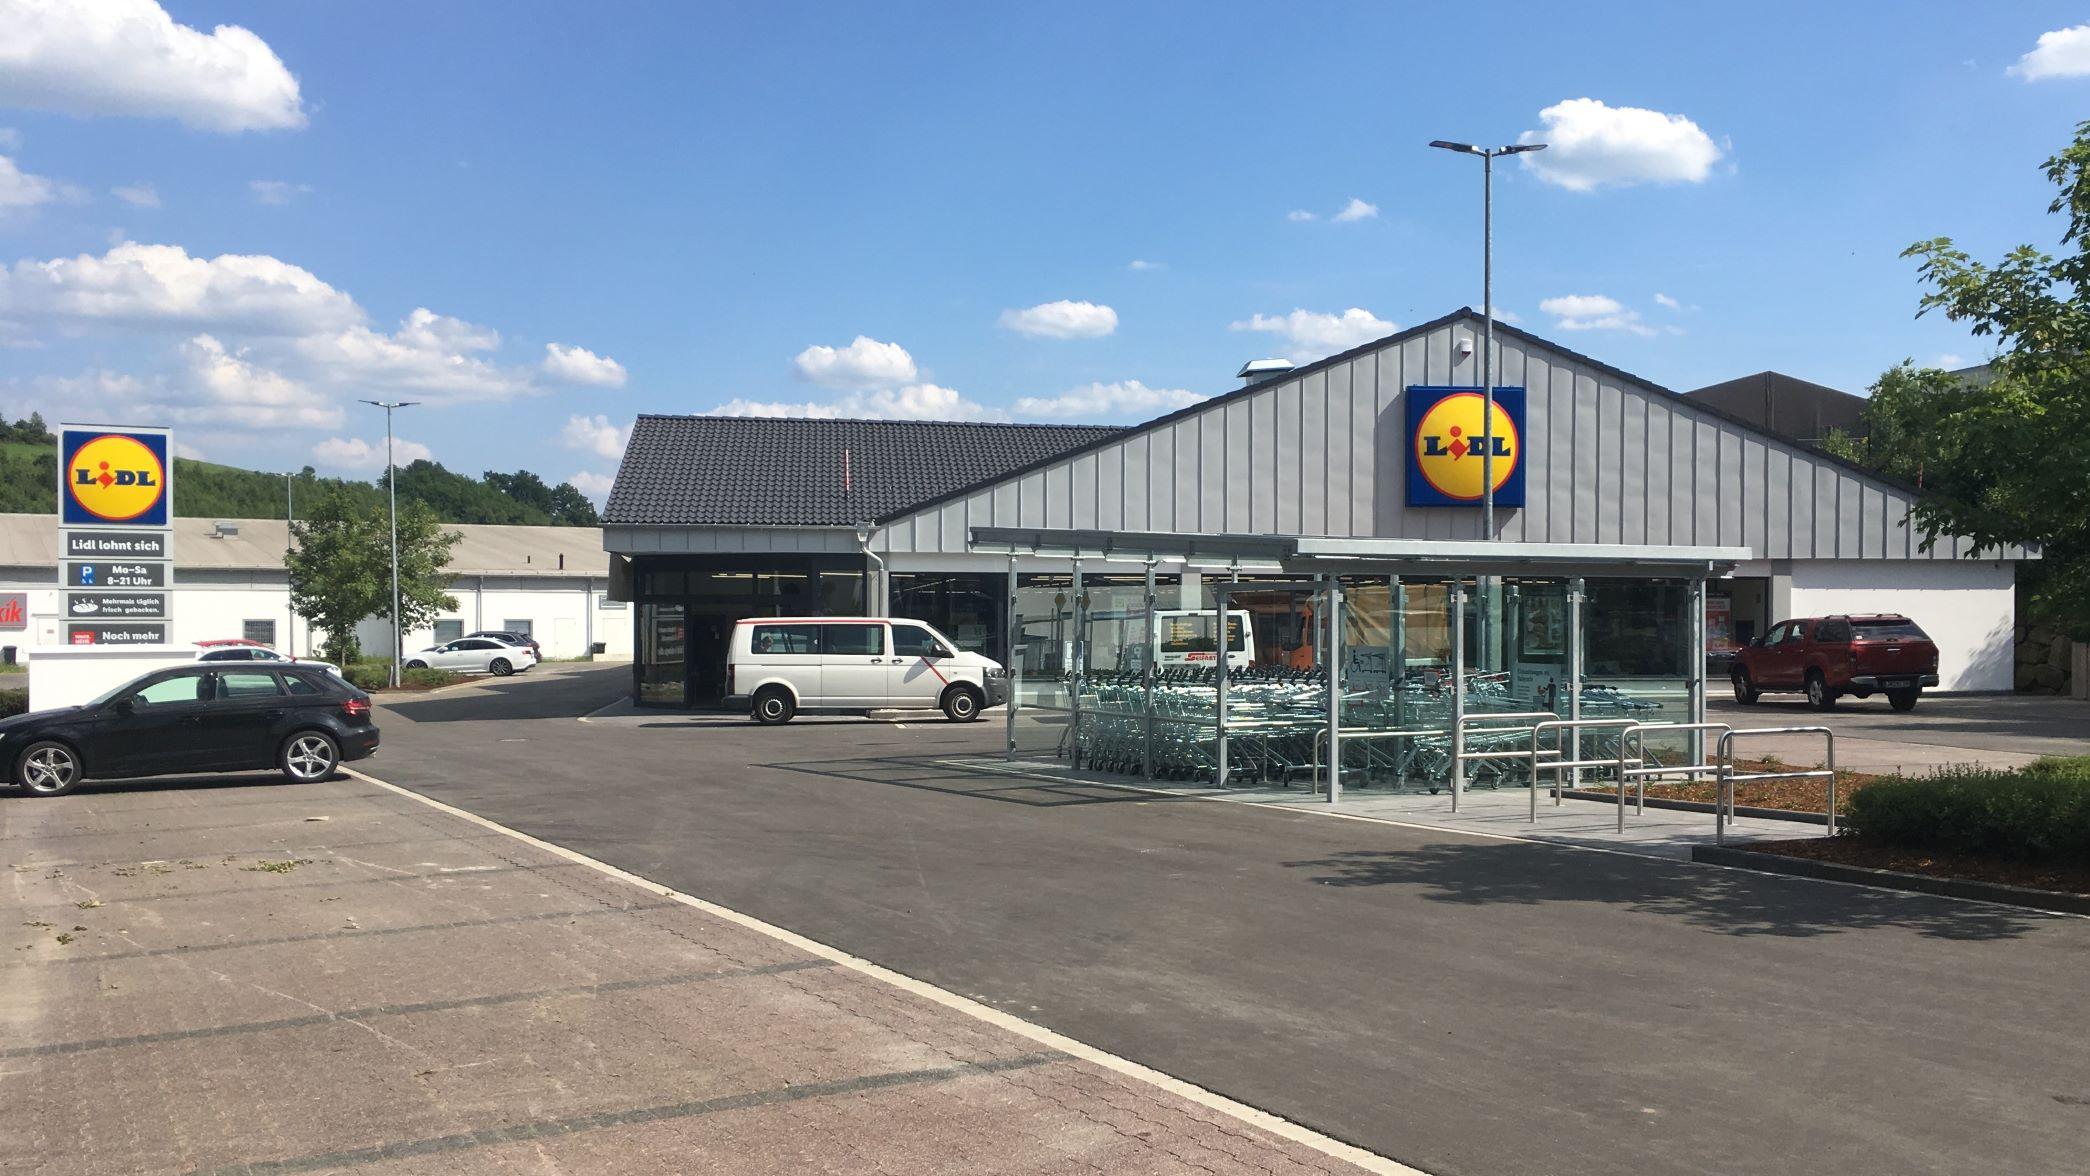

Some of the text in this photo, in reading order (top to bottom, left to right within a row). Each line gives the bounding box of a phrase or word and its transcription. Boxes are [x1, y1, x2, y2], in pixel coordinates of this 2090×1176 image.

[72, 539, 160, 551] Lidl lohnt sich
[82, 566, 93, 577] P
[132, 576, 152, 586] Uhr
[136, 598, 160, 606] täglich
[124, 606, 160, 614] gebacken.
[102, 631, 160, 640] Noch mehr
